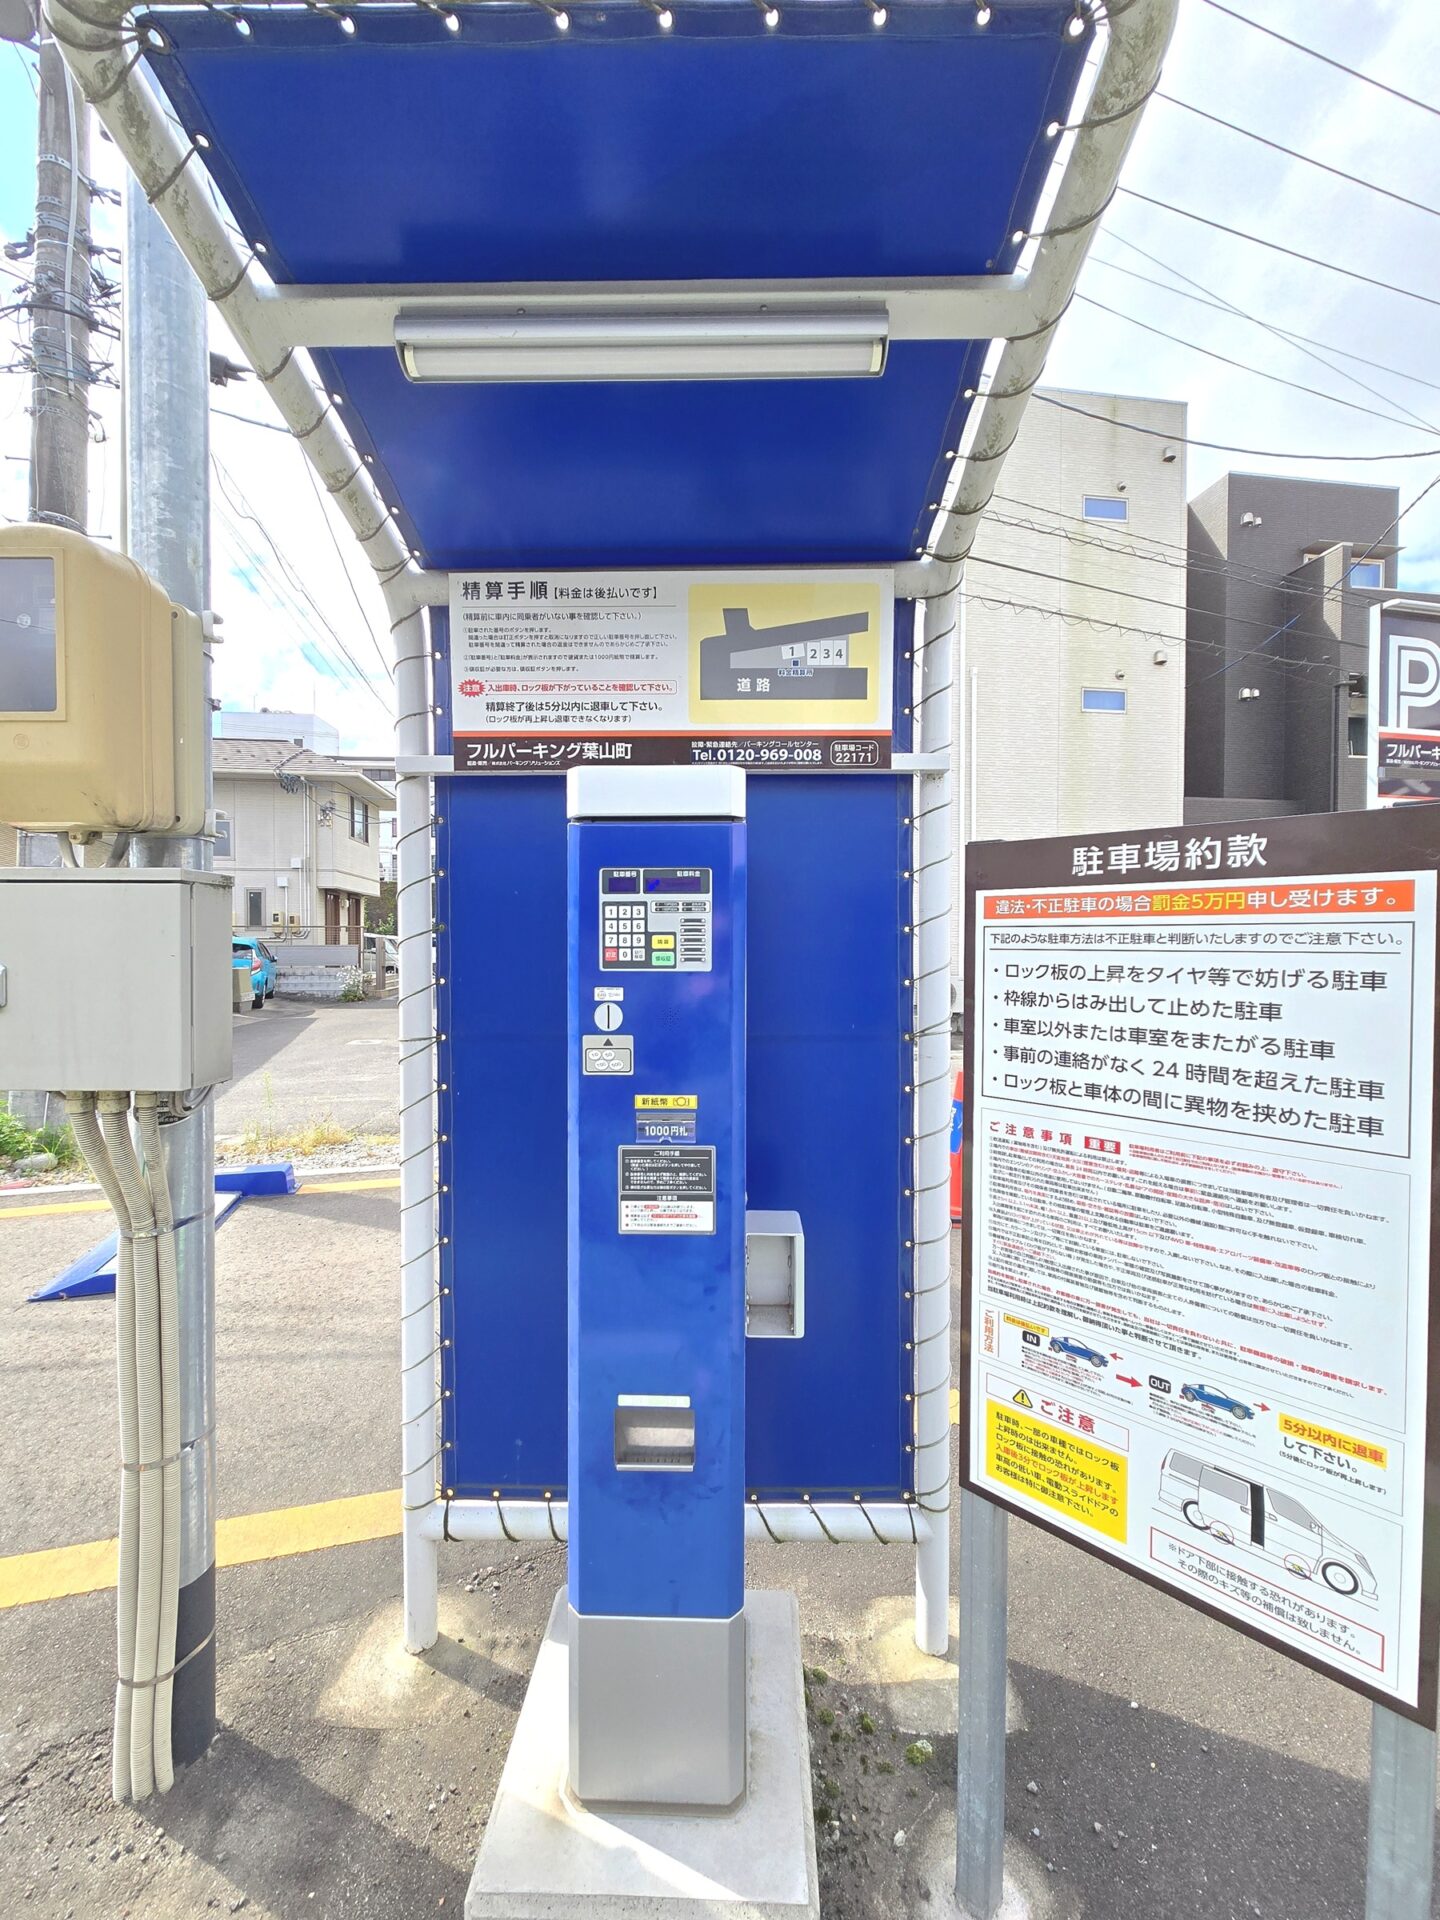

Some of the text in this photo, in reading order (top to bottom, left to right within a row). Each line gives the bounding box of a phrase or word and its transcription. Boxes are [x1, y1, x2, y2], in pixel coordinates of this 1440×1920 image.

[462, 580, 548, 600] 精算手順
[790, 646, 795, 657] 1
[810, 649, 817, 659] 2
[823, 649, 830, 659] 3
[835, 649, 843, 659] 4
[737, 678, 771, 692] 道路
[467, 742, 633, 759] フルパーキング葉山町
[692, 749, 822, 762] Tel.0120-969-008
[835, 752, 873, 763] 22171
[1071, 833, 1269, 876] 駐車場約款
[645, 1126, 688, 1136] 1000円札
[989, 1121, 1072, 1146] ご注意事項
[1026, 1334, 1038, 1345] IN
[1150, 1378, 1171, 1392] OUT
[1041, 1400, 1096, 1434] ご注意
[1283, 1418, 1385, 1464] 5分以内に退車
[1283, 1436, 1358, 1473] して下さい。
